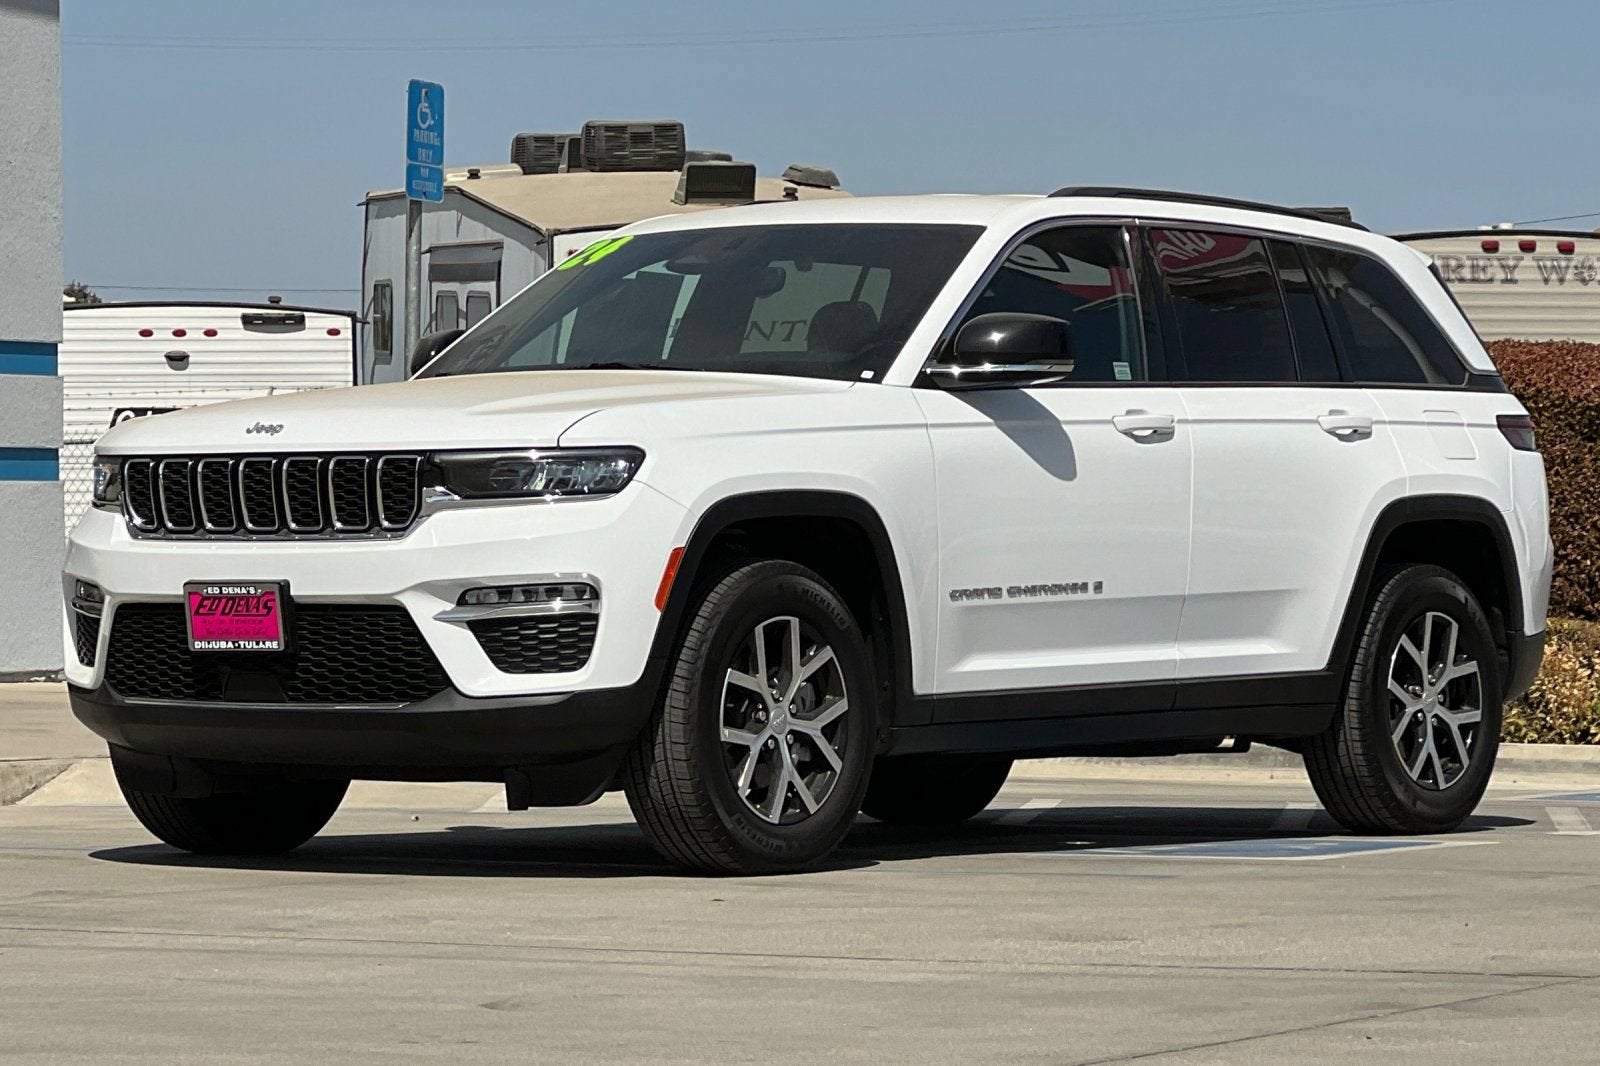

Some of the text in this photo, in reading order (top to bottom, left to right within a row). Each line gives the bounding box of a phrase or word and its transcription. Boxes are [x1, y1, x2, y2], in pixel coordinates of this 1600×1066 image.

[1428, 255, 1524, 285] REY
[245, 421, 285, 437] Jeep
[239, 640, 279, 649] TULARE
